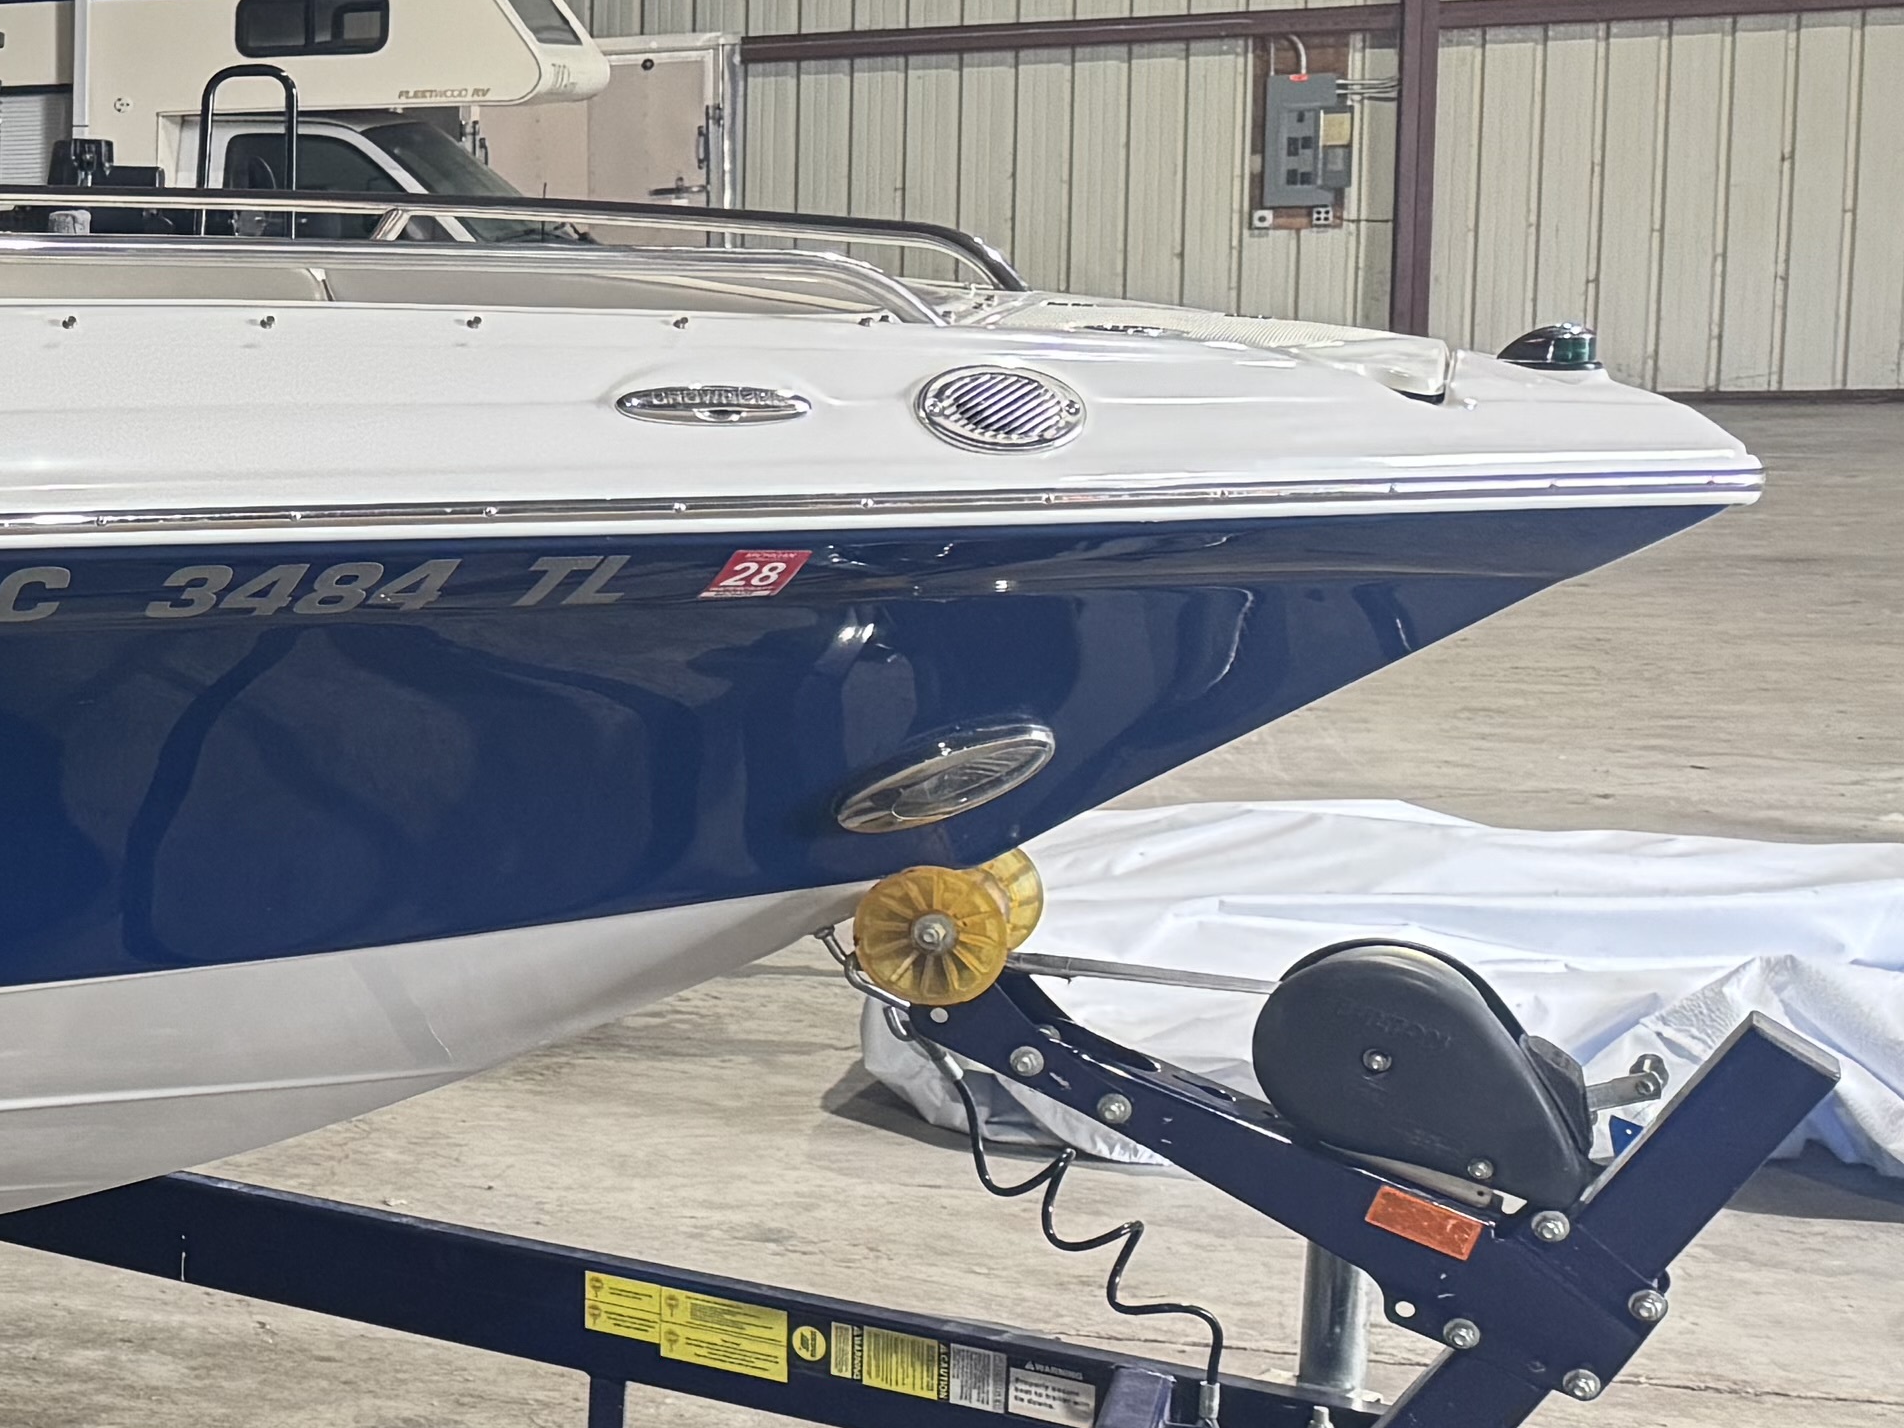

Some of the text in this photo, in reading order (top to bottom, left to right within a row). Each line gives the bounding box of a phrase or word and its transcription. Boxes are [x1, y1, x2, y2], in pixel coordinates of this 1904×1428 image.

[472, 87, 490, 97] RV
[719, 562, 787, 586] 28
[145, 558, 462, 618] 3484
[511, 555, 631, 606] TL
